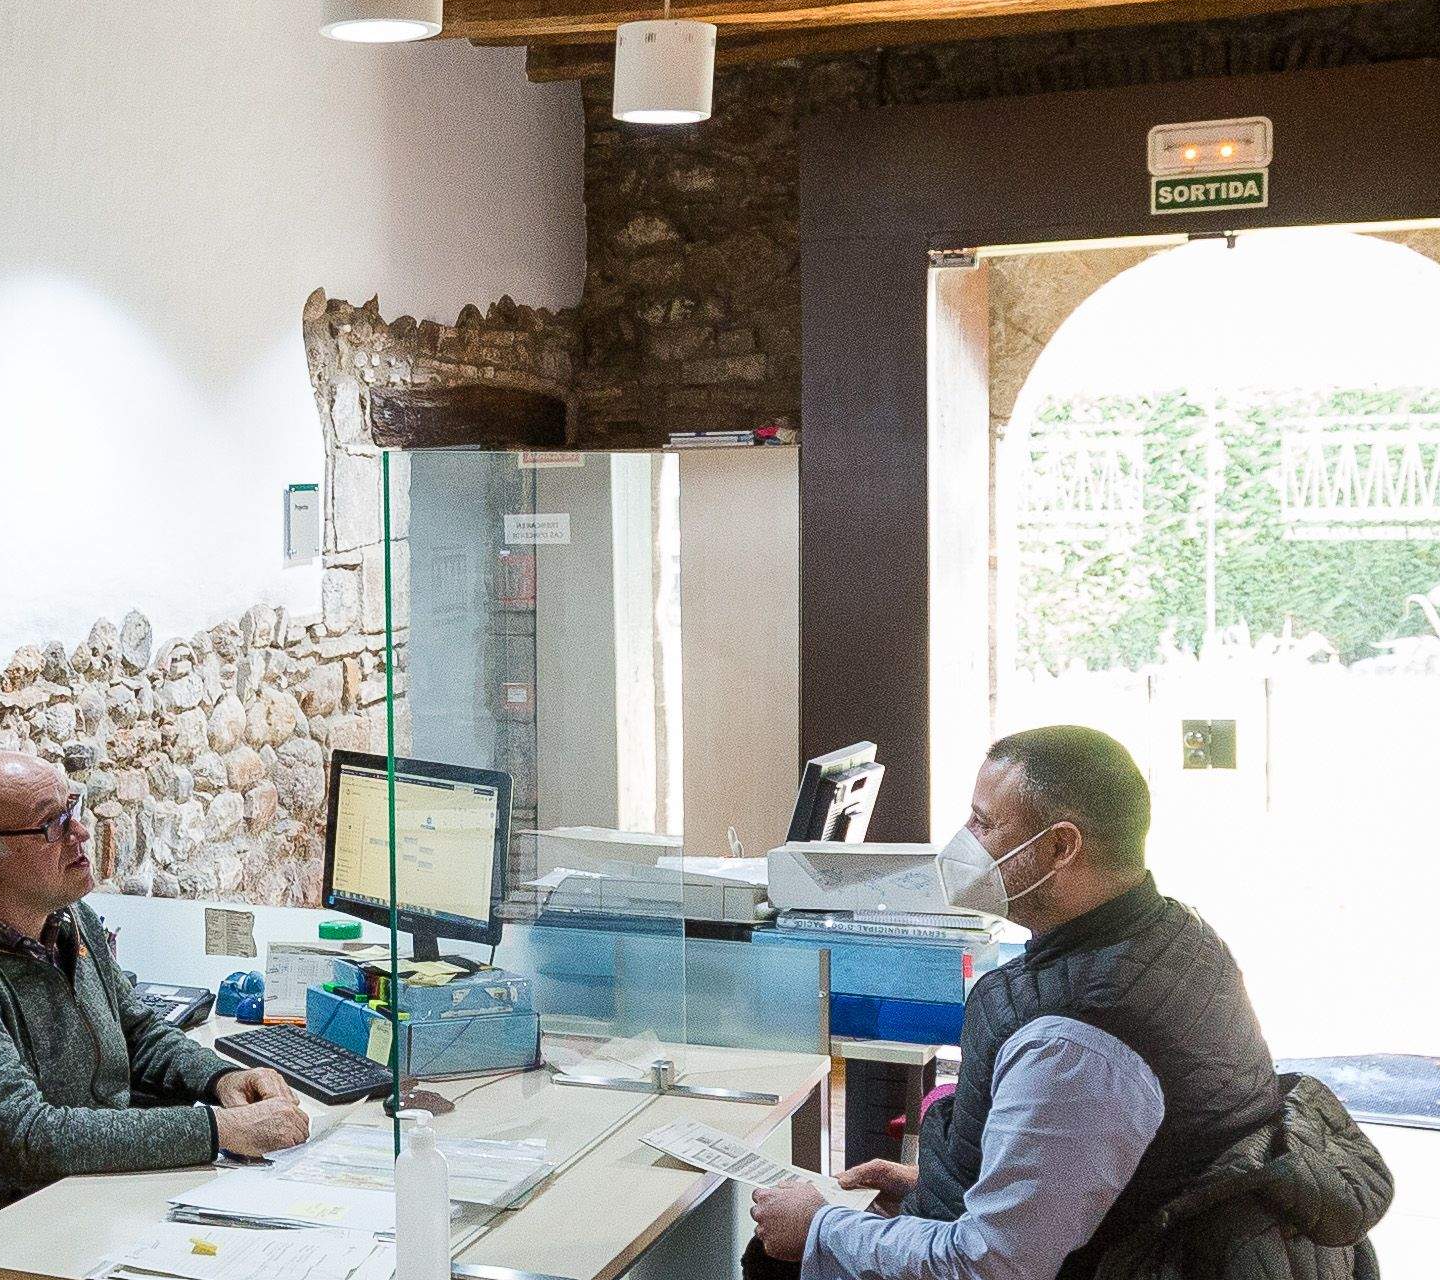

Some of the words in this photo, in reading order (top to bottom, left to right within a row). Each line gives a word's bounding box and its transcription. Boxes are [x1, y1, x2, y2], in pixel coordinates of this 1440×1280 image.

[1158, 180, 1260, 204] SORTIDA
[857, 925, 909, 934] MUNICIPAL
[913, 928, 947, 939] SERVEI
